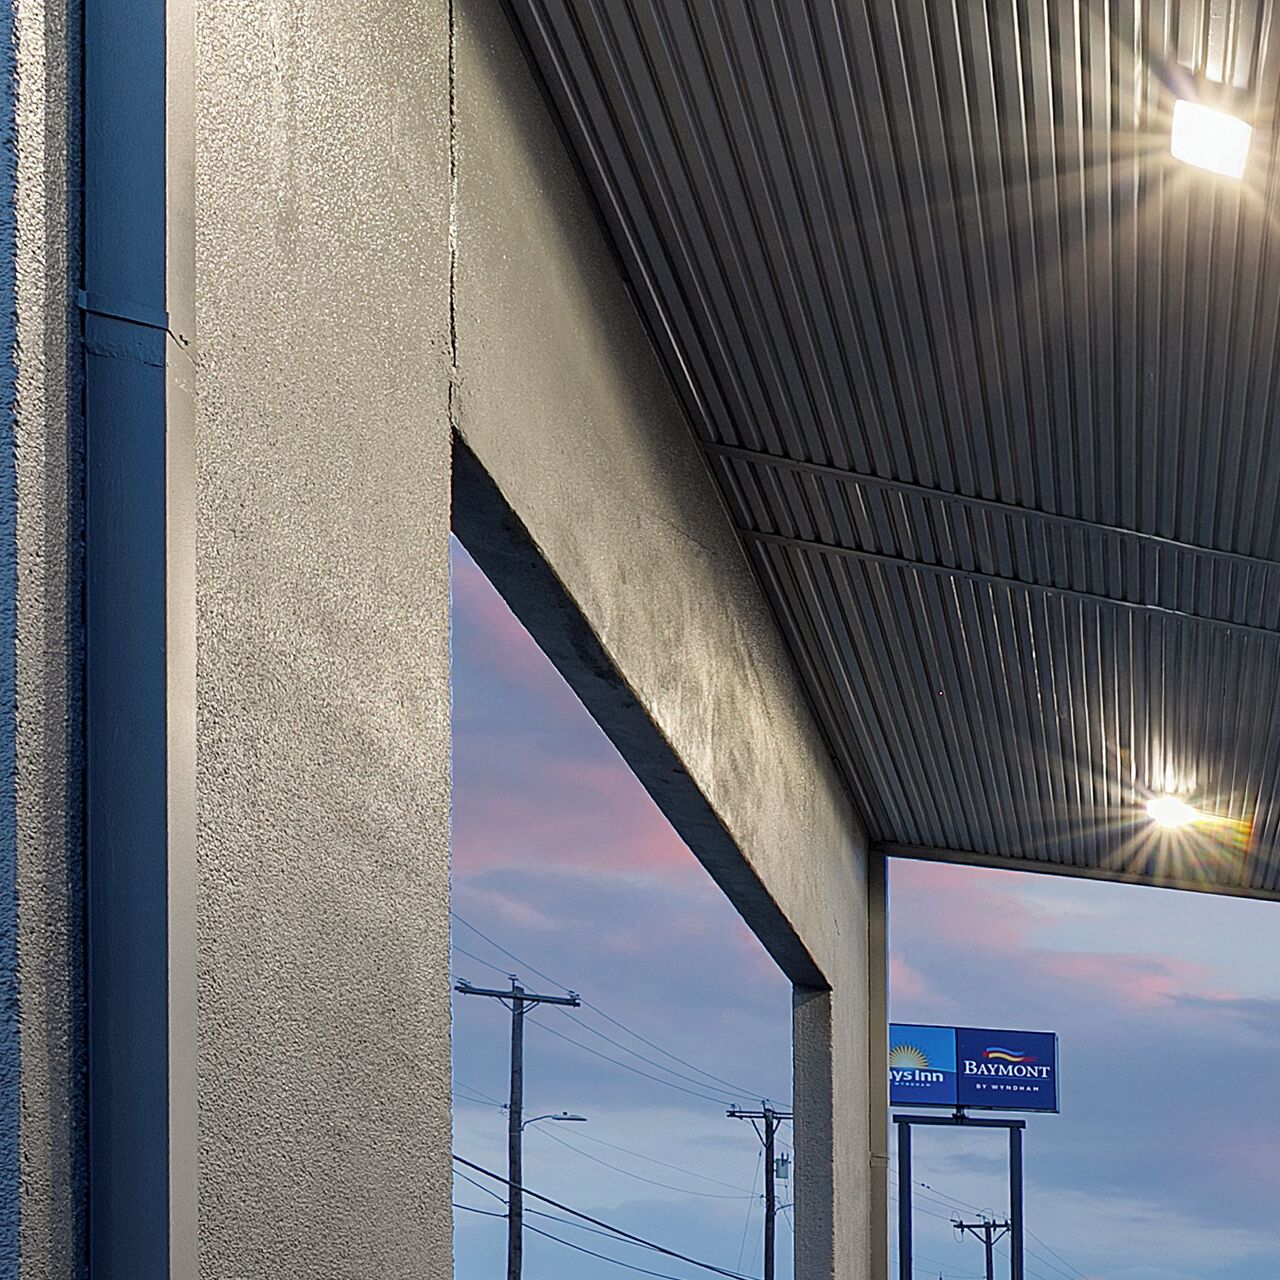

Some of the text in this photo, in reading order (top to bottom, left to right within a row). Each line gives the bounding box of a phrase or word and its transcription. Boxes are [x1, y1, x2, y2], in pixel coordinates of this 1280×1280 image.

[964, 1060, 1050, 1078] BAYMONT
[915, 1070, 943, 1082] Inn
[991, 1084, 1039, 1092] WYNDHAM
